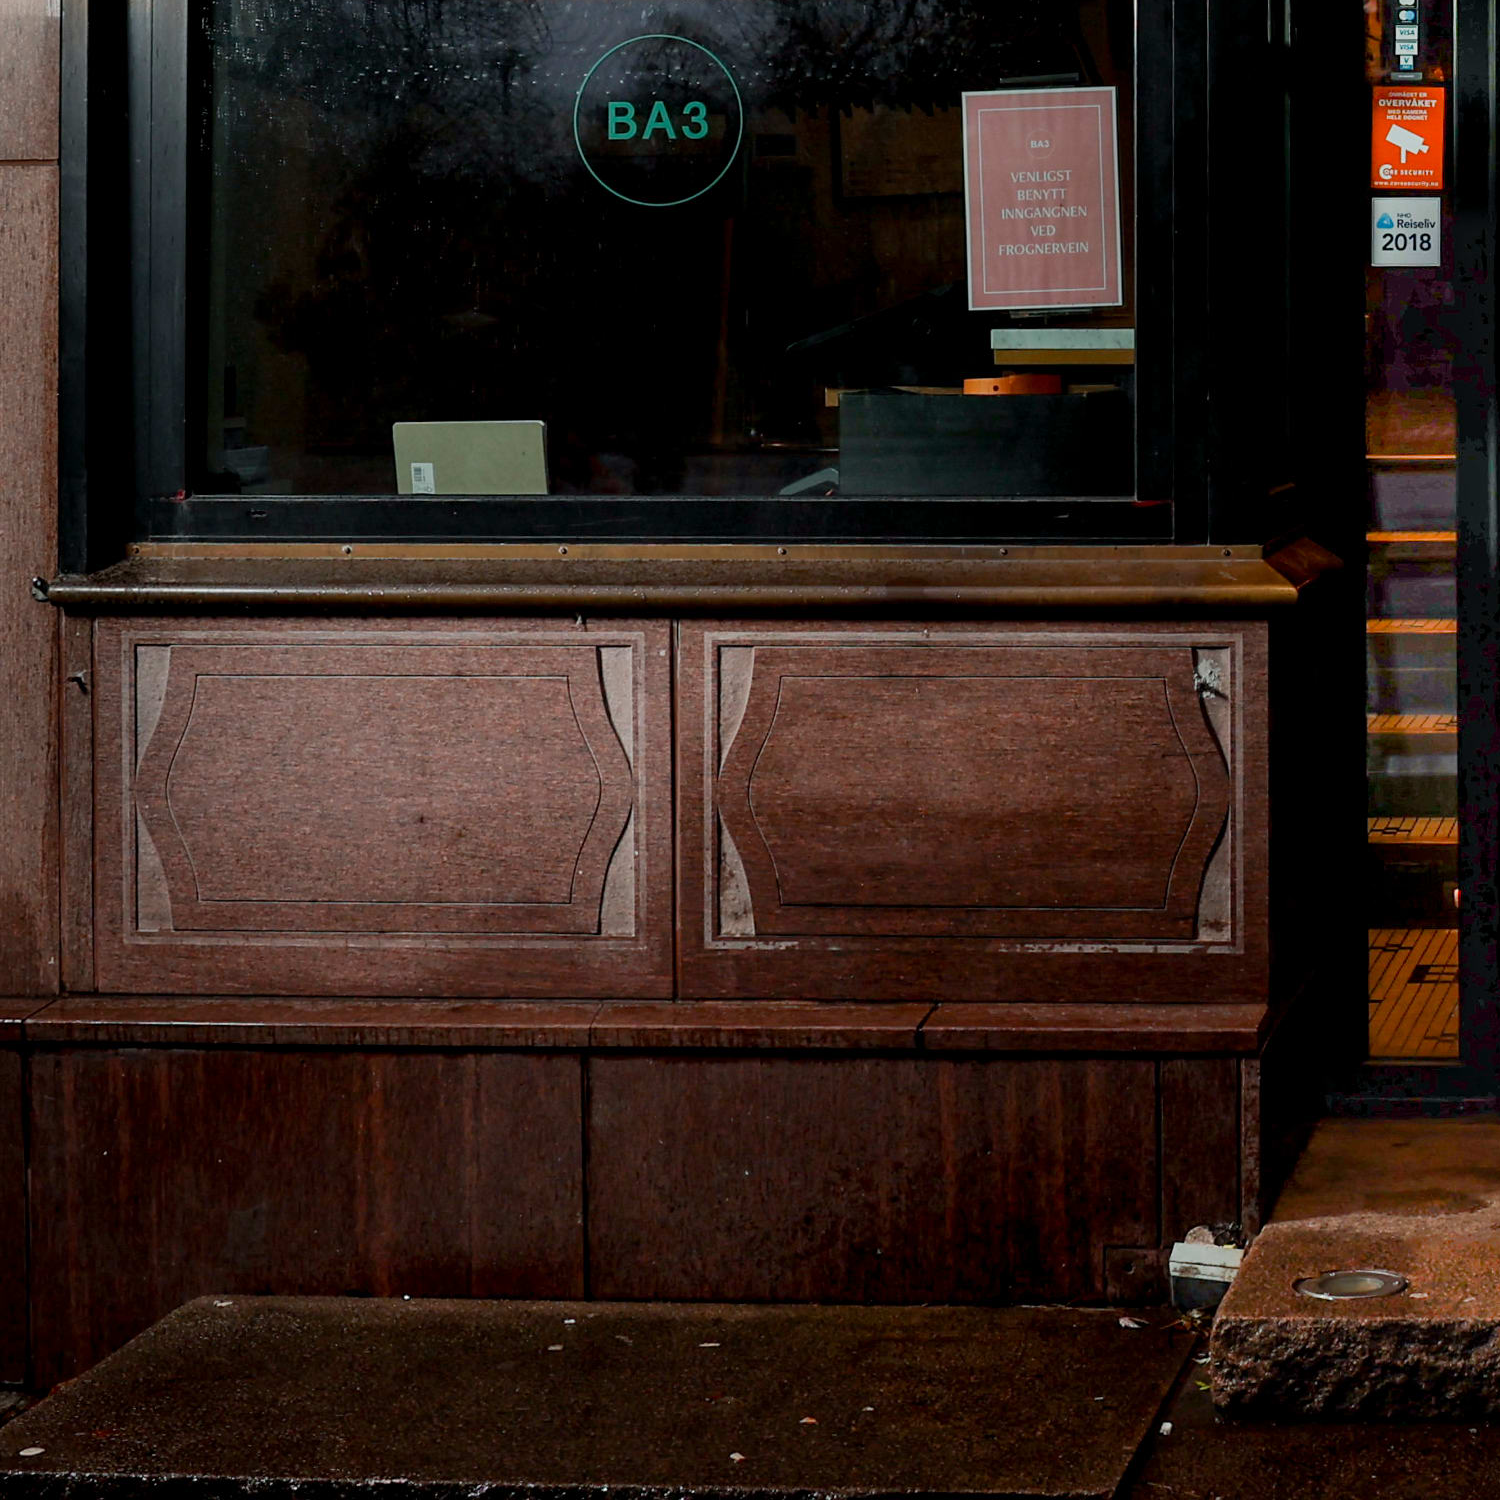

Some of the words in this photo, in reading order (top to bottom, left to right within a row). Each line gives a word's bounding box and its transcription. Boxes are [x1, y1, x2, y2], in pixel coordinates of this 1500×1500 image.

[1379, 98, 1438, 108] OVERVÅKET
[607, 100, 709, 140] BA3
[1030, 139, 1050, 149] BA3
[1010, 169, 1072, 183] VENLIGST
[1017, 188, 1067, 201] BENYTT
[1001, 205, 1087, 220] INNGANGNEN
[1397, 218, 1436, 228] Reiseliv
[1030, 225, 1056, 237] VED
[998, 241, 1089, 256] FROGNERVEIN
[1382, 233, 1431, 251] 2018
